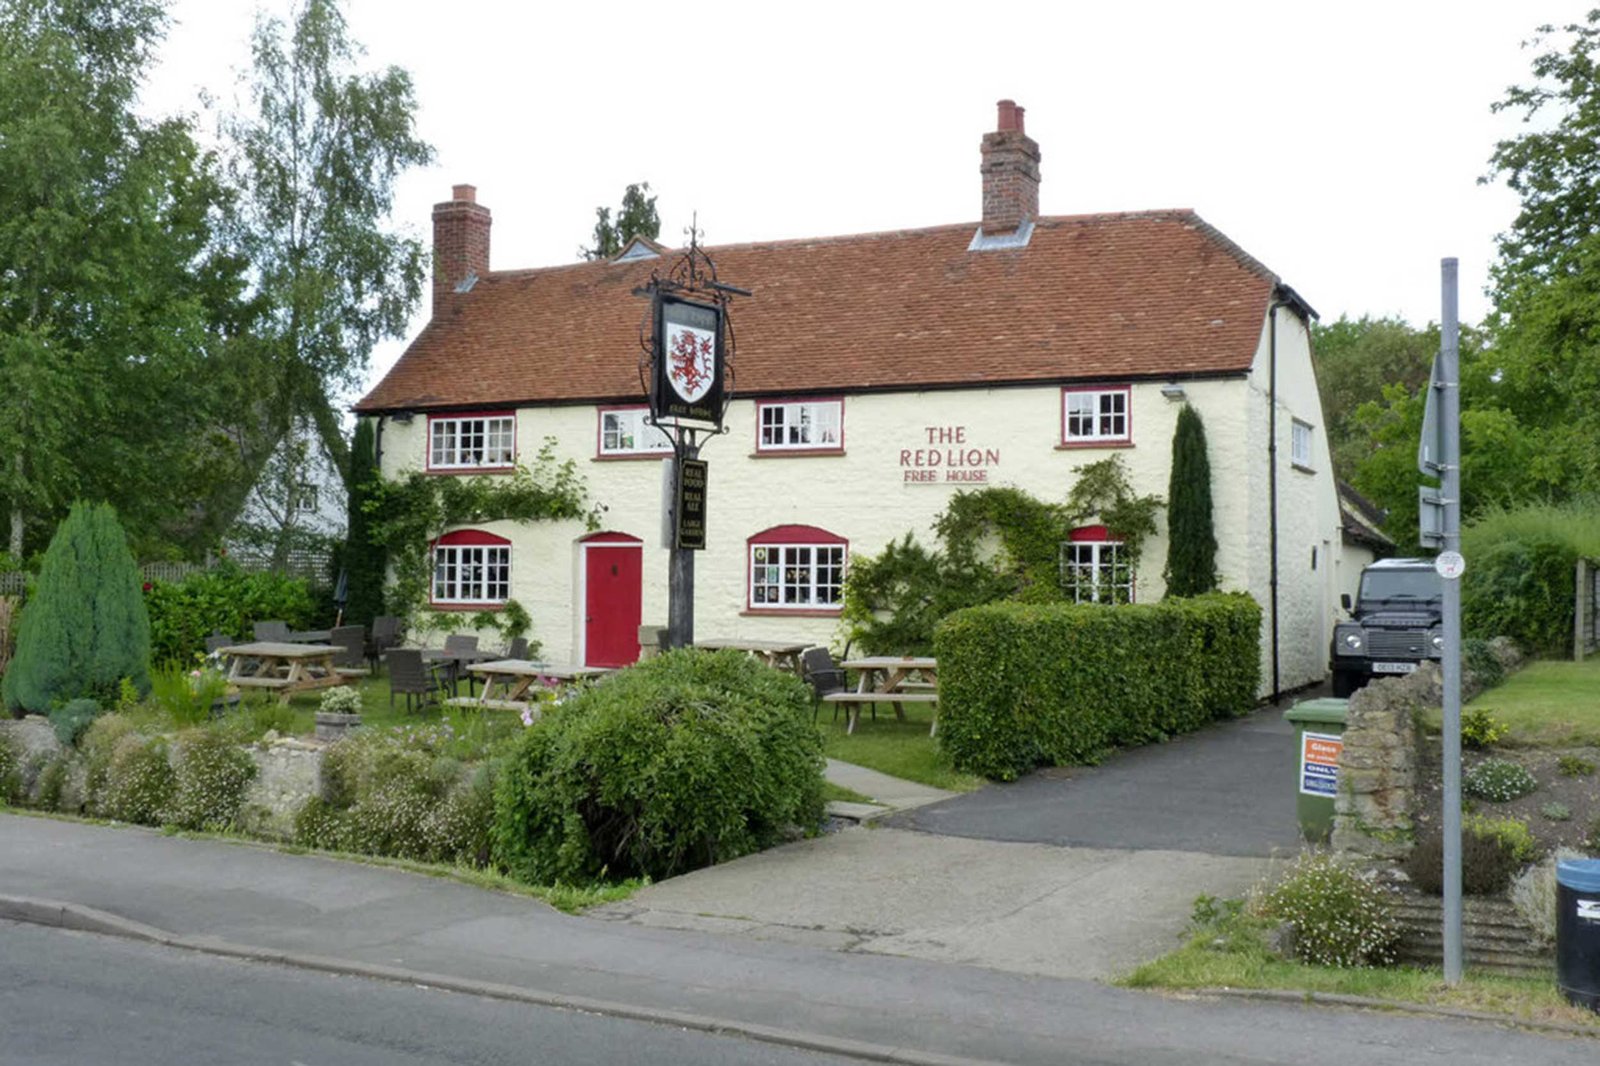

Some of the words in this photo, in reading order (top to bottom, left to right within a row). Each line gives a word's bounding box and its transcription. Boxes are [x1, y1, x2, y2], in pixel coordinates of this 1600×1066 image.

[925, 426, 966, 444] THE
[900, 449, 942, 467] RED
[947, 448, 1000, 467] LION
[904, 470, 937, 482] FREE
[946, 470, 987, 482] HOUSE
